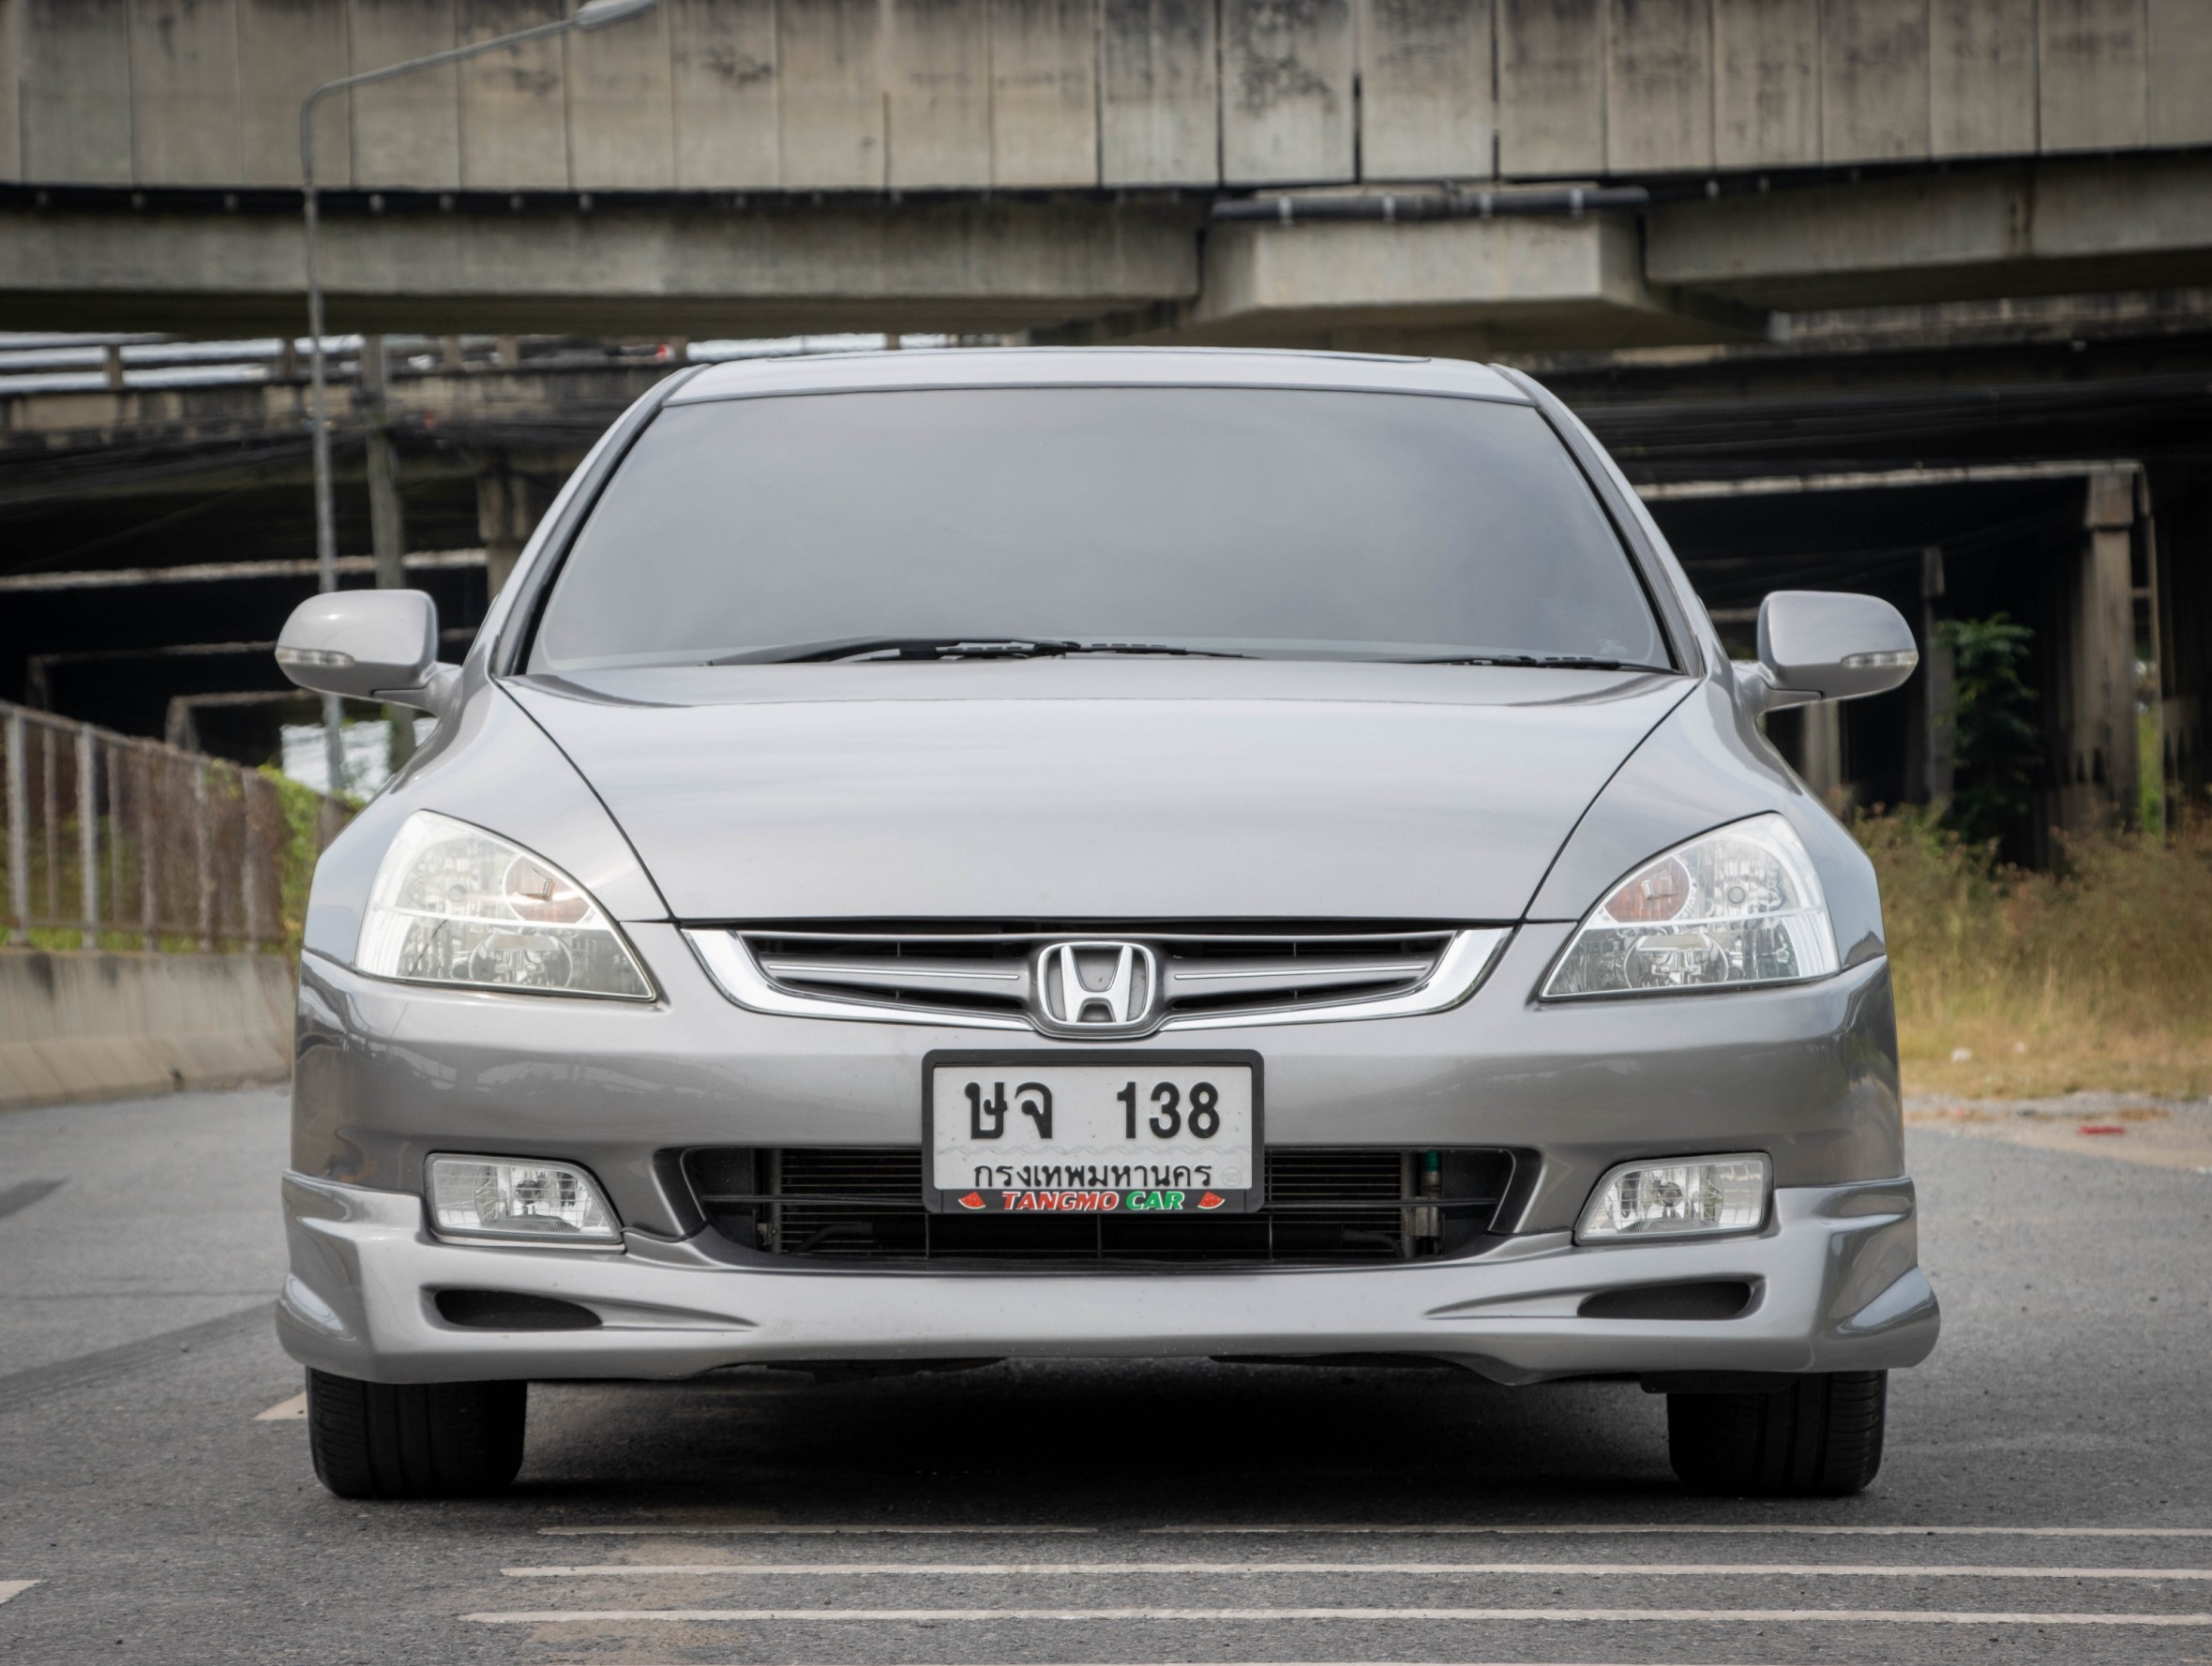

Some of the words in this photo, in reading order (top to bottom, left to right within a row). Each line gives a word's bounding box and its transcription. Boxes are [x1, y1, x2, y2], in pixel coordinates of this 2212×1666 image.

[964, 1081, 1053, 1139] ษจ
[1117, 1081, 1220, 1139] 138
[973, 1164, 1212, 1187] กรงเทพมหานคร
[1001, 1191, 1120, 1212] TANGMO
[1125, 1191, 1185, 1211] CAR
